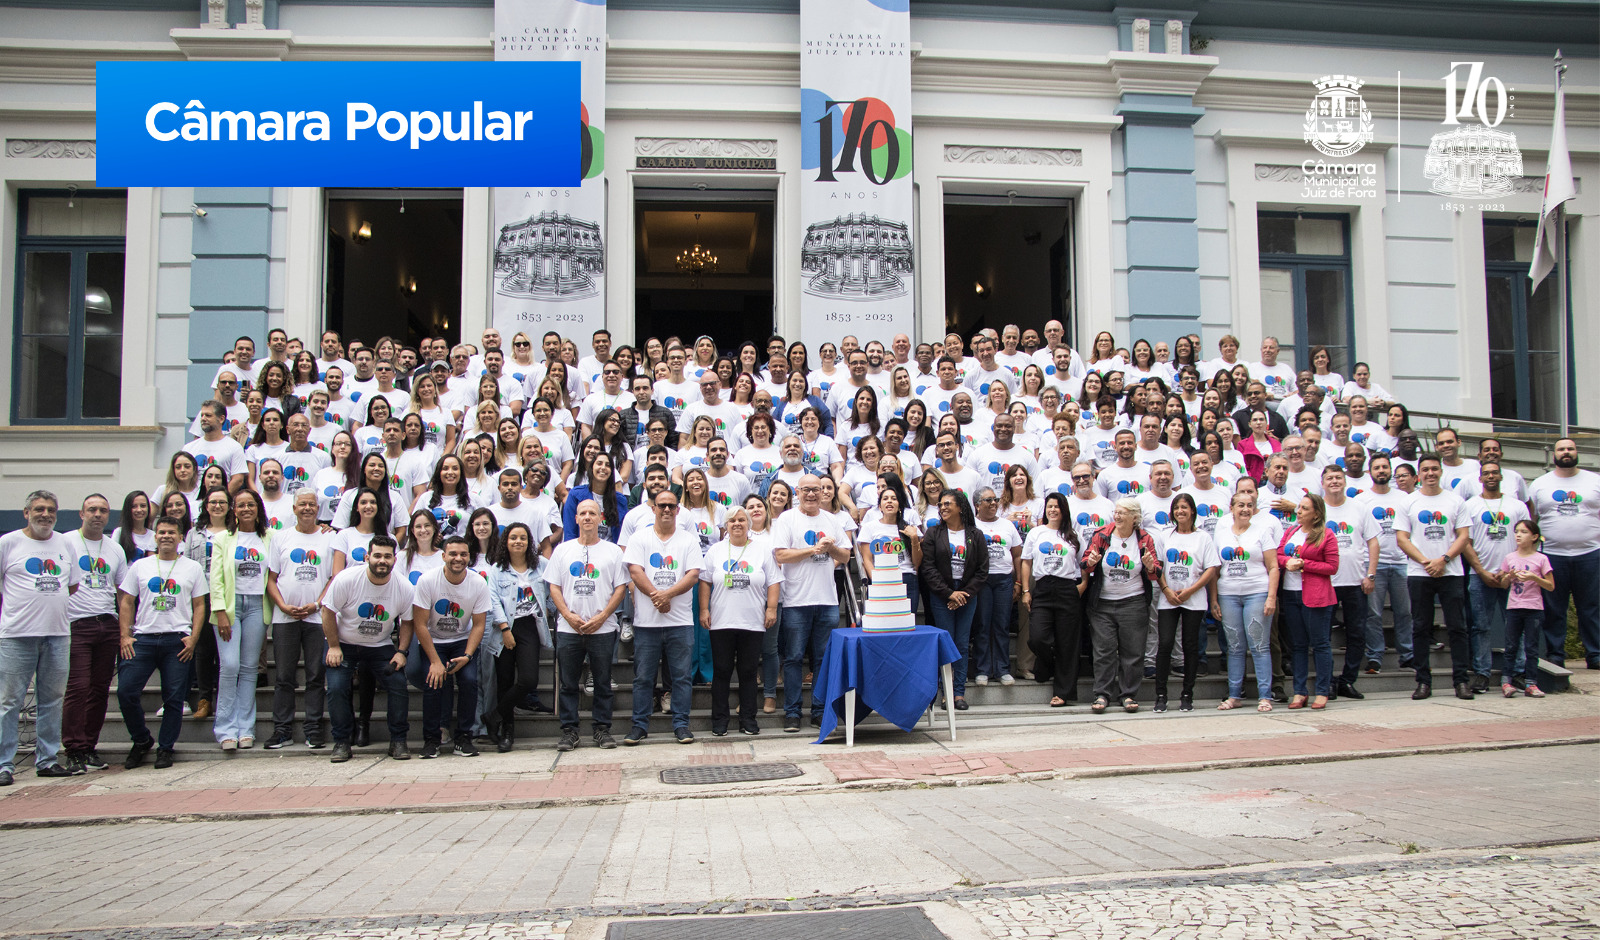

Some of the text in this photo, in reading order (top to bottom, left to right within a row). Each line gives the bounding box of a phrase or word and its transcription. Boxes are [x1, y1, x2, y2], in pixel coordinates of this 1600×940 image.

[566, 44, 599, 52] FORA
[813, 100, 900, 186] 170
[704, 159, 776, 169] MUNICIPAL
[524, 189, 571, 199] ANOS
[830, 191, 878, 199] ANOS
[516, 311, 542, 323] 1853
[555, 313, 584, 323] 2023
[825, 311, 852, 323] 1853
[865, 313, 893, 323] 2023
[873, 541, 903, 554] 170
